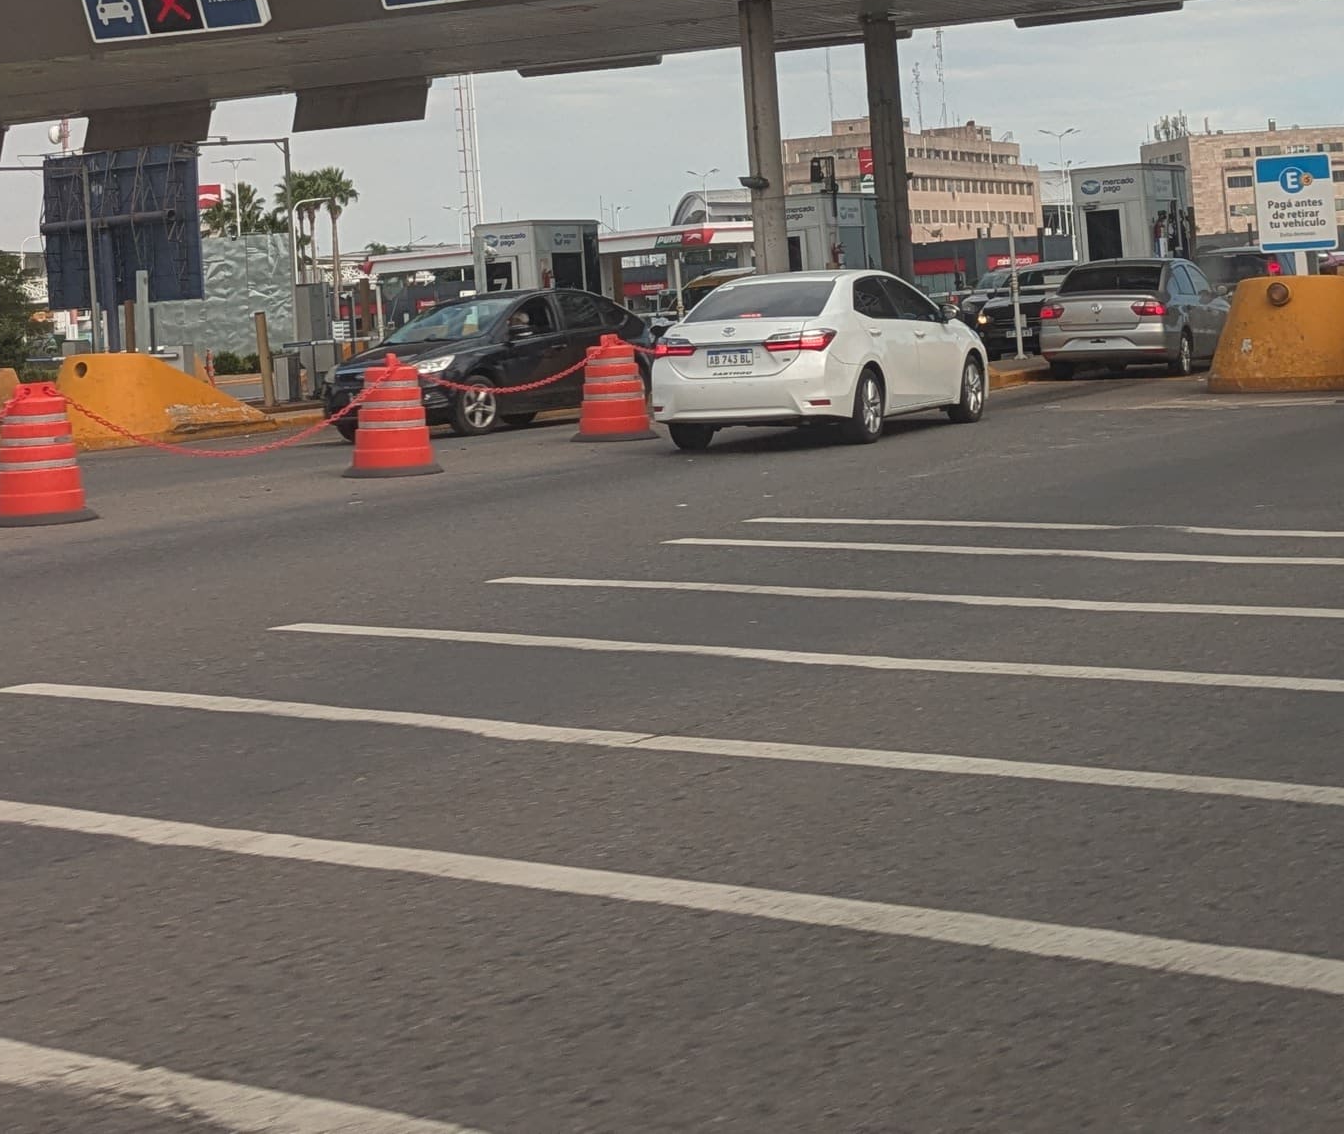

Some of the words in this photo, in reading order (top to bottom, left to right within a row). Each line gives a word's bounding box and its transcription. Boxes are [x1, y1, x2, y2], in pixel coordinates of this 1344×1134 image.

[1286, 172, 1299, 189] E
[1268, 199, 1293, 210] Pagá
[1294, 198, 1323, 207] antes
[1272, 211, 1285, 220] de
[1287, 210, 1320, 219] retirar
[1269, 221, 1280, 229] tu
[1282, 218, 1326, 228] vehículo
[657, 234, 682, 244] PUMA
[709, 356, 720, 365] AB
[722, 355, 738, 364] 743
[740, 355, 751, 364] BL
